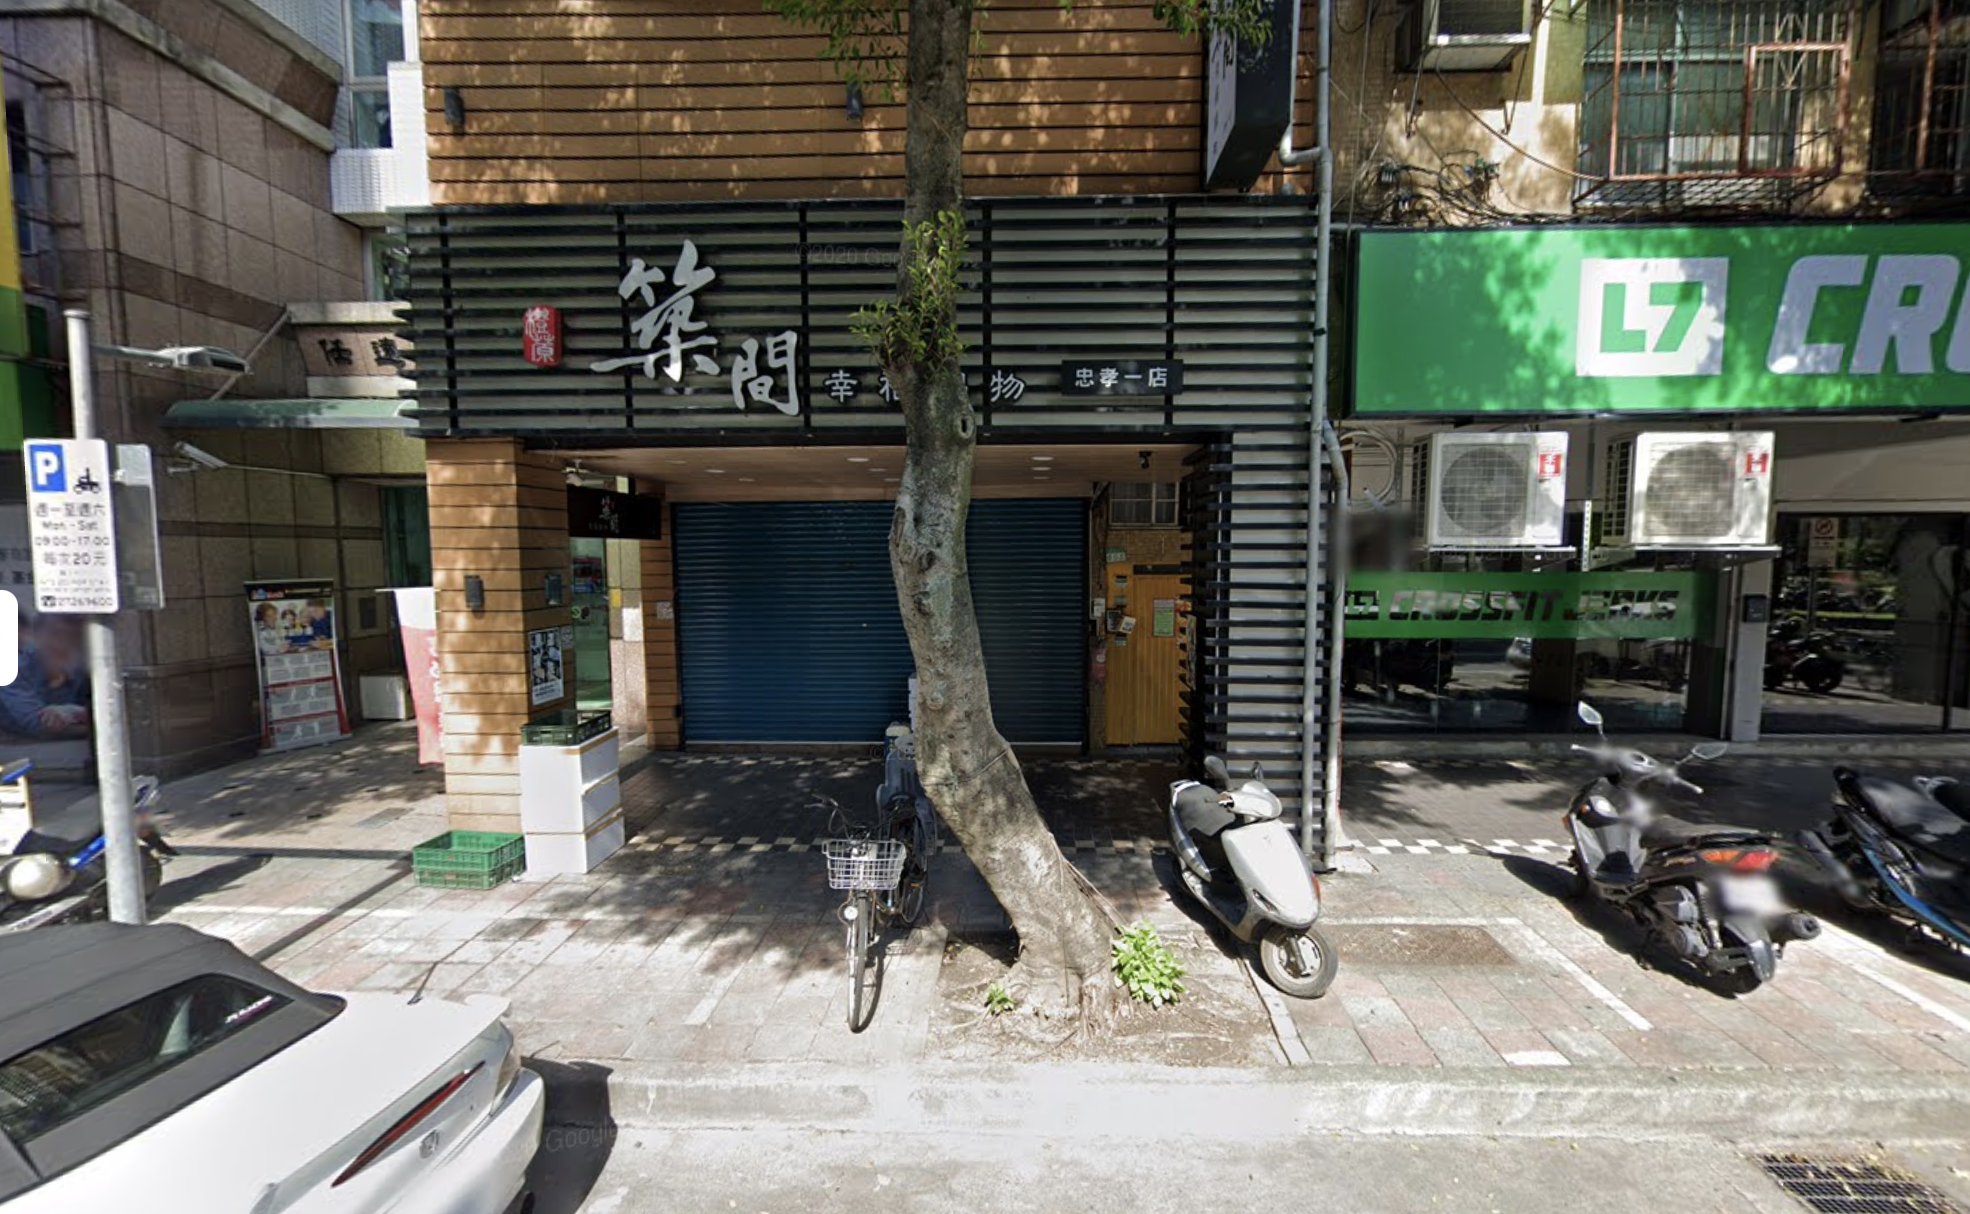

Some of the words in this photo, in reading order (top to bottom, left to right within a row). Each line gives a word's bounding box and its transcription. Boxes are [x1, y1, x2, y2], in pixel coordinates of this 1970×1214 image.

[825, 369, 1025, 403] 幸物
[1074, 366, 1169, 388] 忠孝一店
[36, 451, 59, 485] P
[41, 520, 67, 531] Mon
[77, 520, 98, 531] Sat
[1389, 590, 1564, 621] CROSSFIT
[1562, 590, 1680, 621] JERKS
